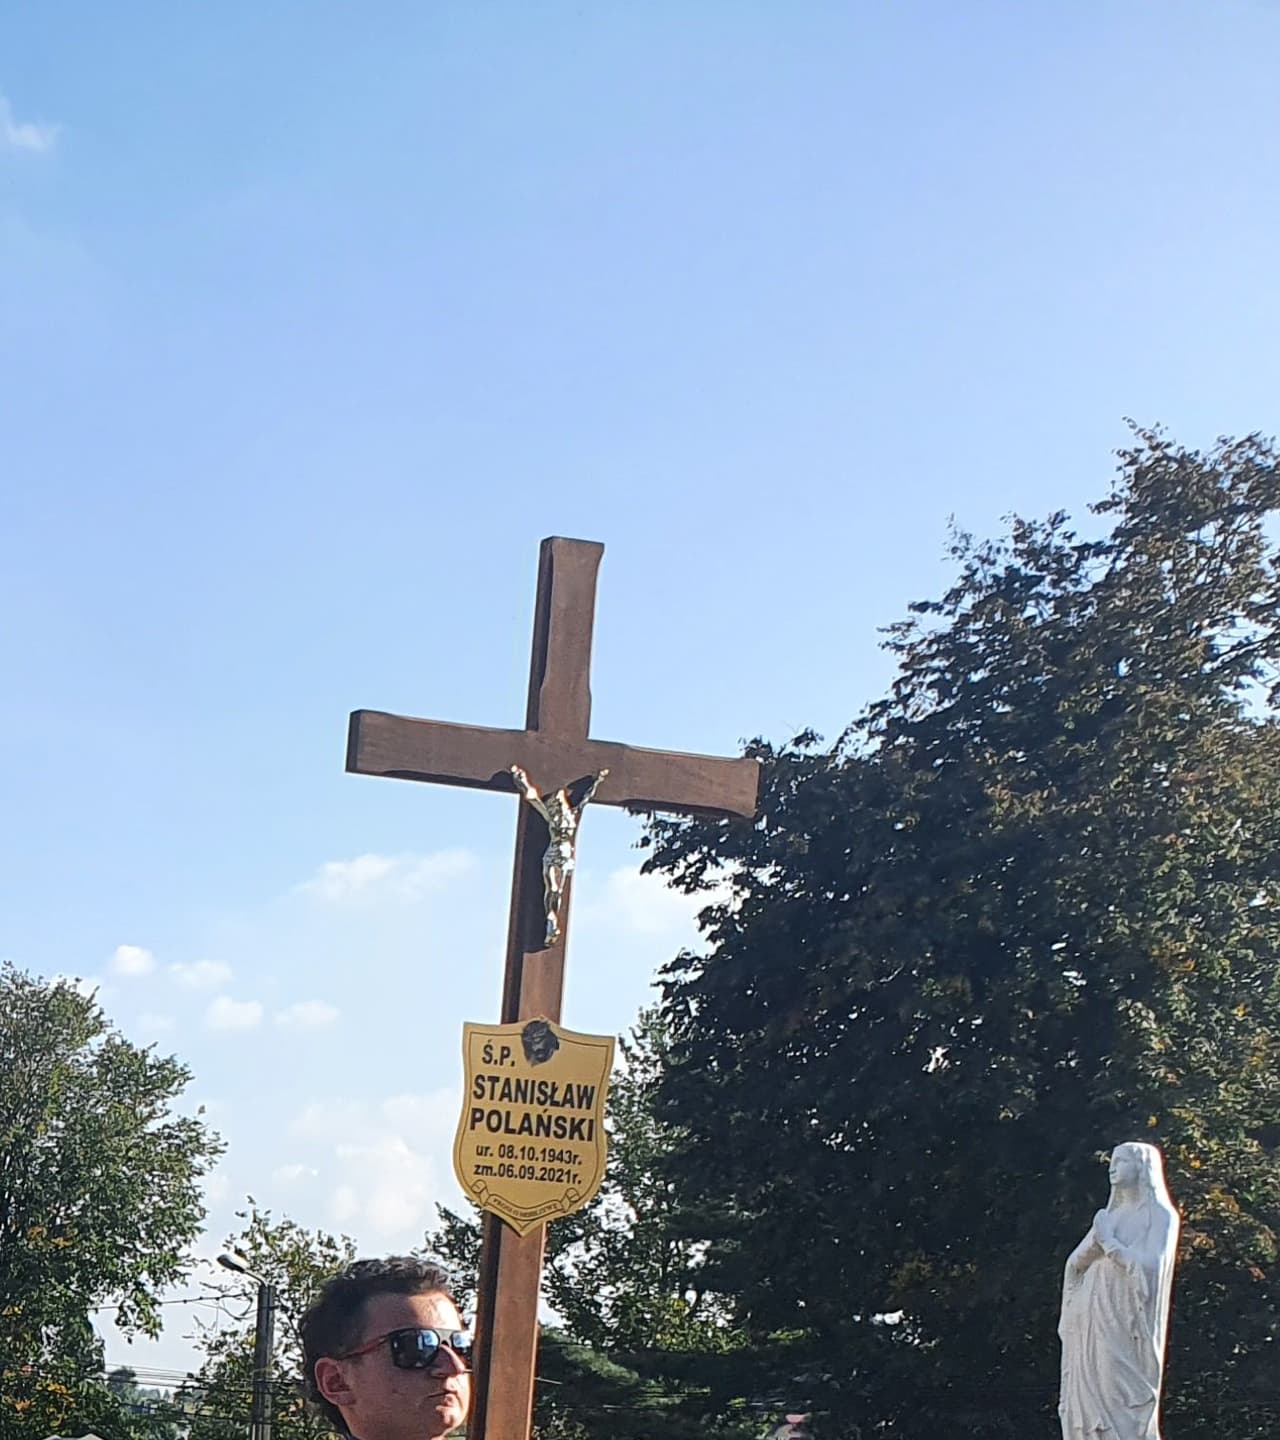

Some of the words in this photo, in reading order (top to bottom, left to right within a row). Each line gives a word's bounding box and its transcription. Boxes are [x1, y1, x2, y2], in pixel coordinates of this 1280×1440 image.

[482, 1039, 515, 1067] Ś.P.
[472, 1074, 595, 1110] STANISŁAW
[469, 1107, 594, 1142] POLAŃSKI
[476, 1144, 493, 1157] ur.
[498, 1143, 582, 1165] 08.10.1943r.
[473, 1163, 582, 1185] zm.06.09.2021r.
